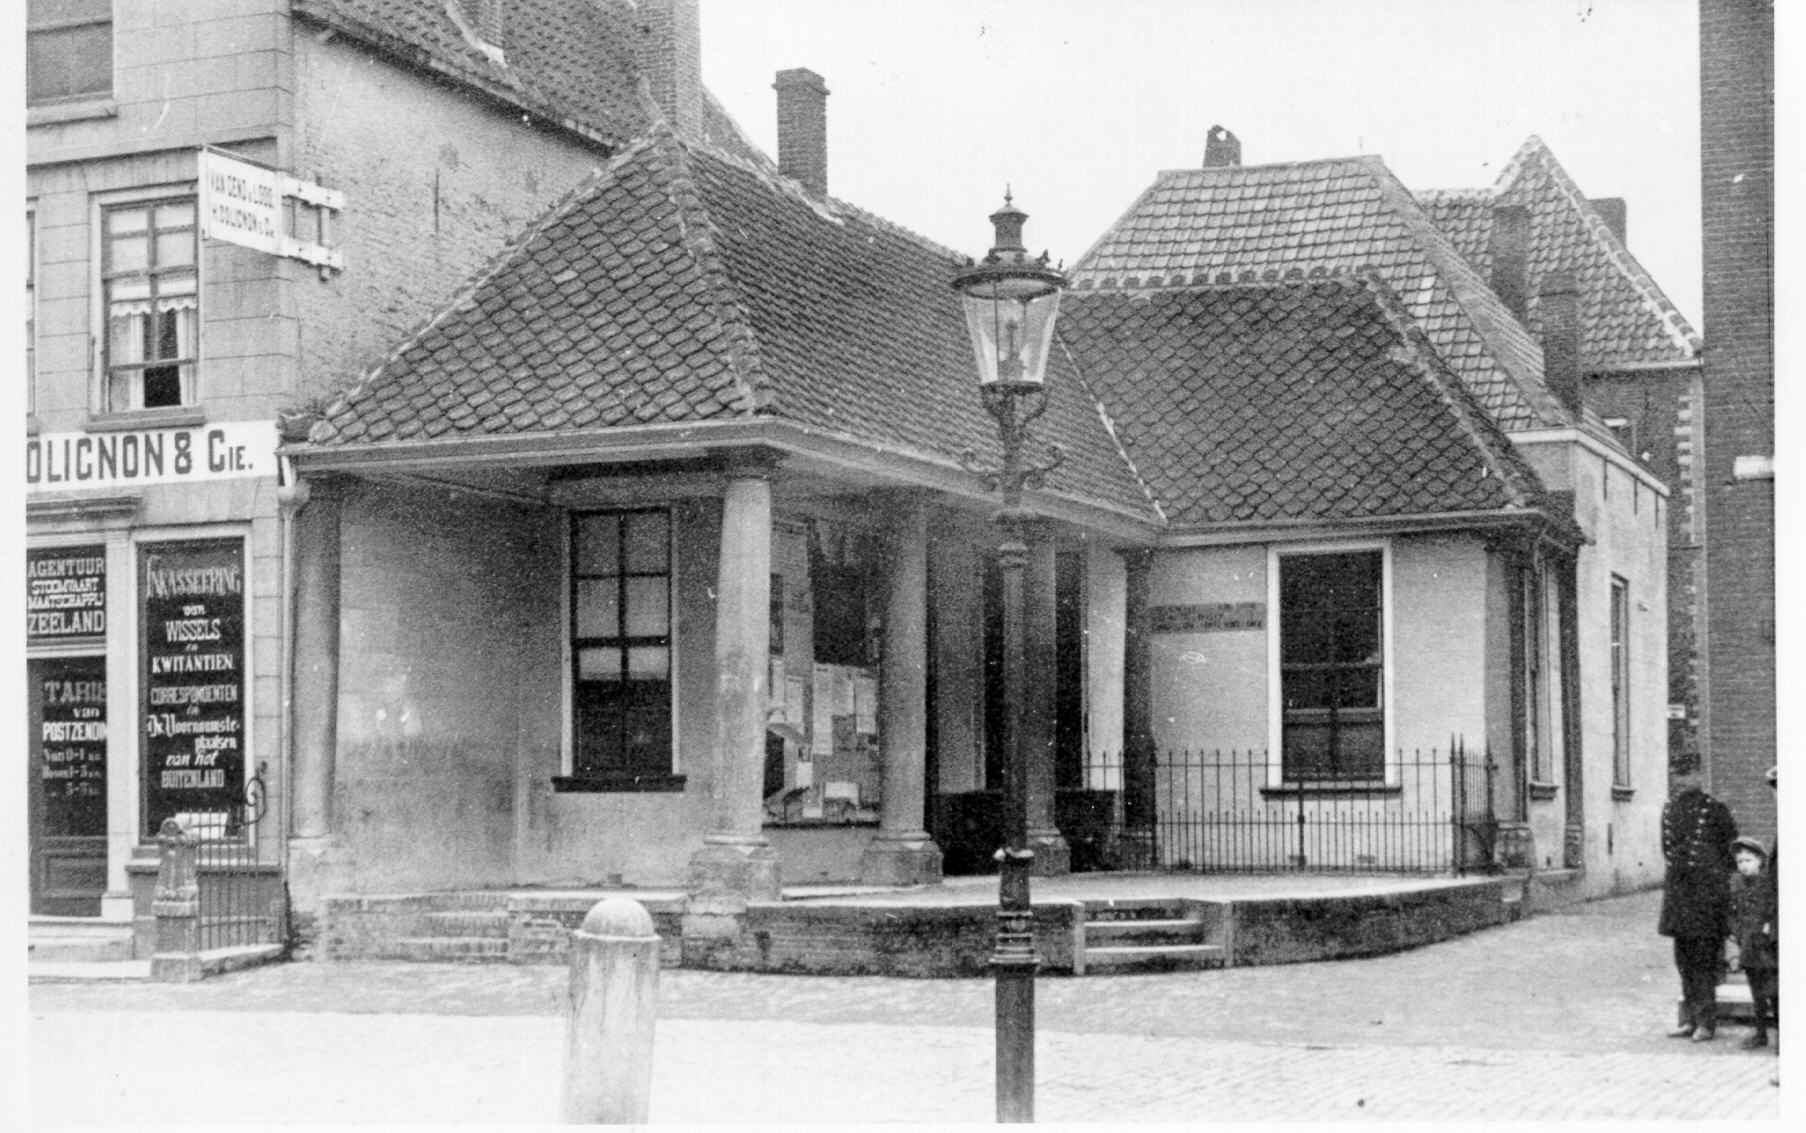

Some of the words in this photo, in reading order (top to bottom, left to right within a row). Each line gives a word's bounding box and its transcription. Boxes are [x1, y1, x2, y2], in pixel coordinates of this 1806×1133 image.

[26, 432, 164, 484] OLIGNON
[174, 431, 193, 475] &
[27, 557, 105, 578] AGENTUUR
[32, 577, 99, 595] STOOMVAART
[182, 604, 206, 616] van
[27, 610, 105, 634] ZEELAND
[165, 618, 221, 642] WISSELS
[150, 684, 238, 705] CORRESPONDENTEN
[72, 707, 101, 719] van
[166, 754, 191, 767] van
[194, 750, 220, 767] het
[161, 769, 225, 789] BUITENLAND
